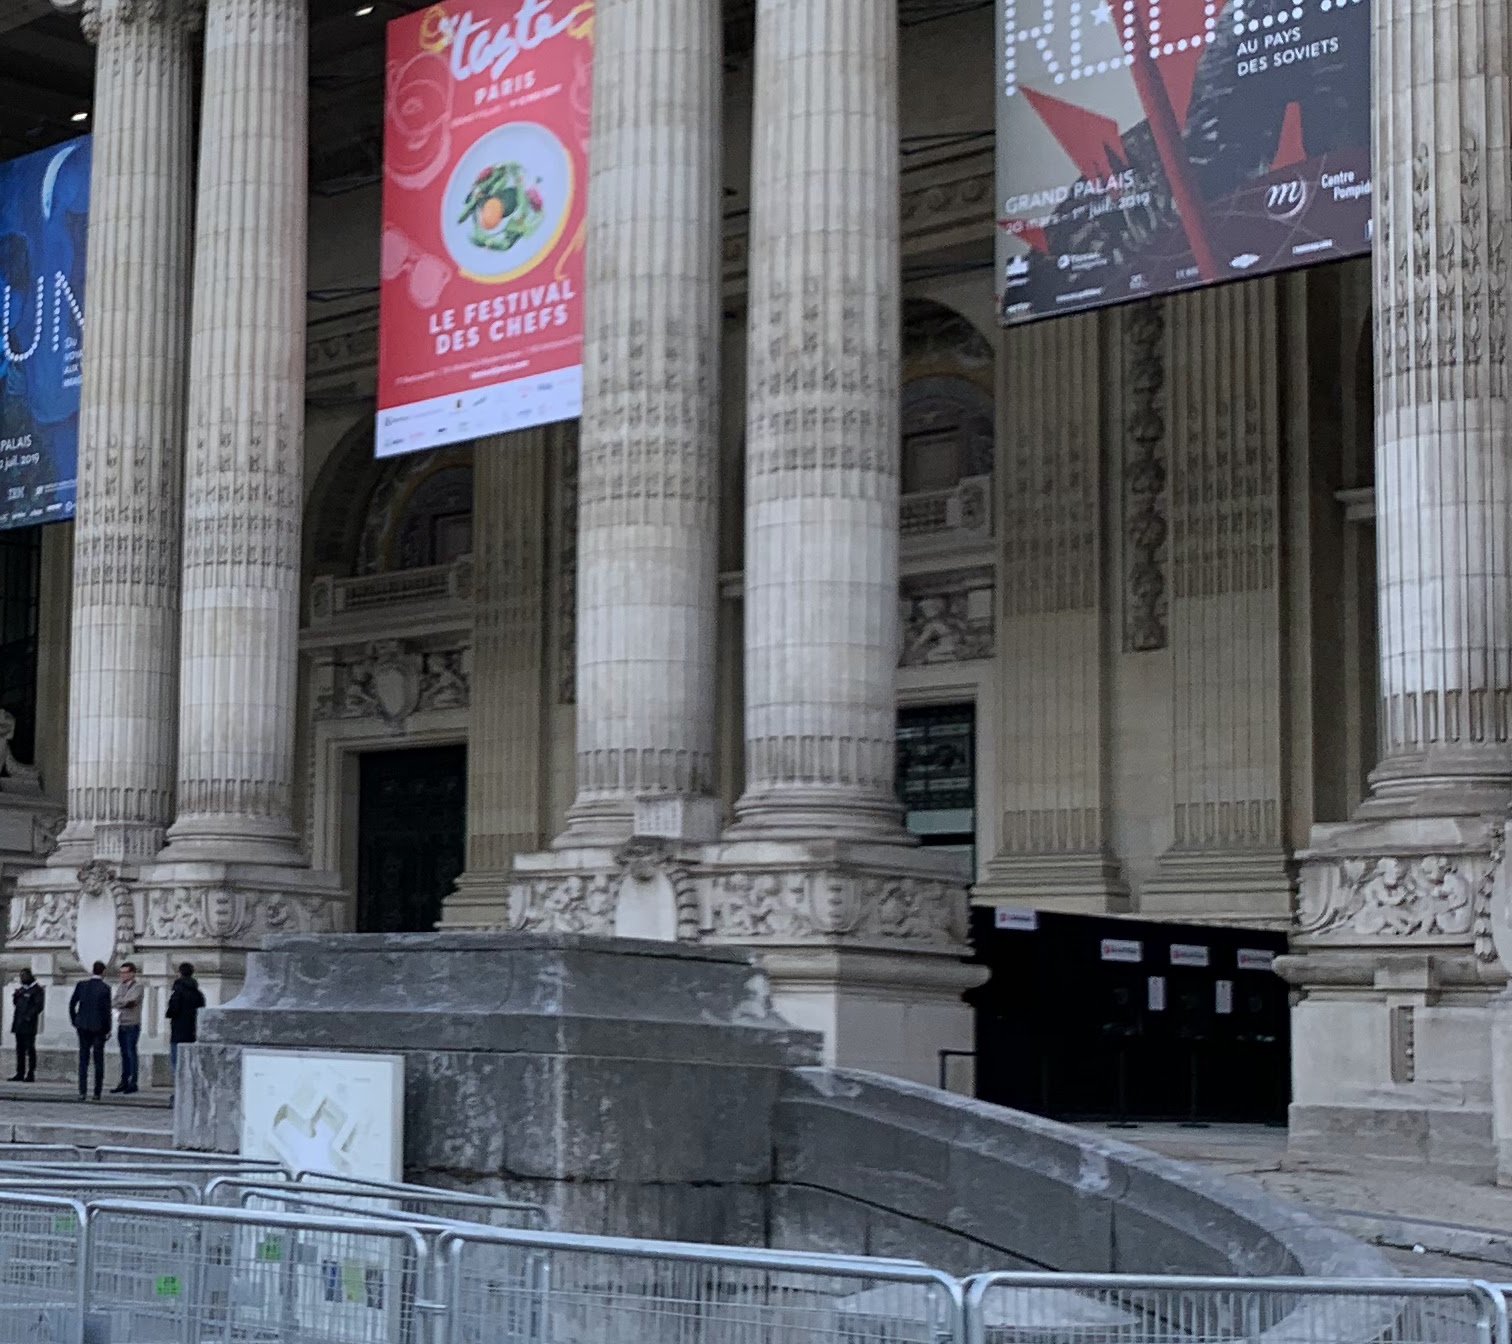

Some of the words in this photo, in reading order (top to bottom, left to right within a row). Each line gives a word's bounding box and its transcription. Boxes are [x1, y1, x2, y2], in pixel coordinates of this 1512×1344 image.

[1237, 38, 1258, 57] AU
[1264, 27, 1301, 49] PAYS
[1237, 56, 1268, 76] DES
[1273, 37, 1339, 67] SOVIETS
[475, 70, 536, 105] PARIS
[1005, 185, 1069, 214] GRAND
[1074, 168, 1136, 199] PALAIS
[1321, 170, 1355, 189] Centre
[1118, 192, 1151, 209] 2019
[429, 308, 455, 334] LE
[464, 279, 575, 325] FESTIVAL
[435, 326, 480, 355] DES
[489, 304, 568, 342] CHEFS
[0, 434, 32, 452] PALAIS
